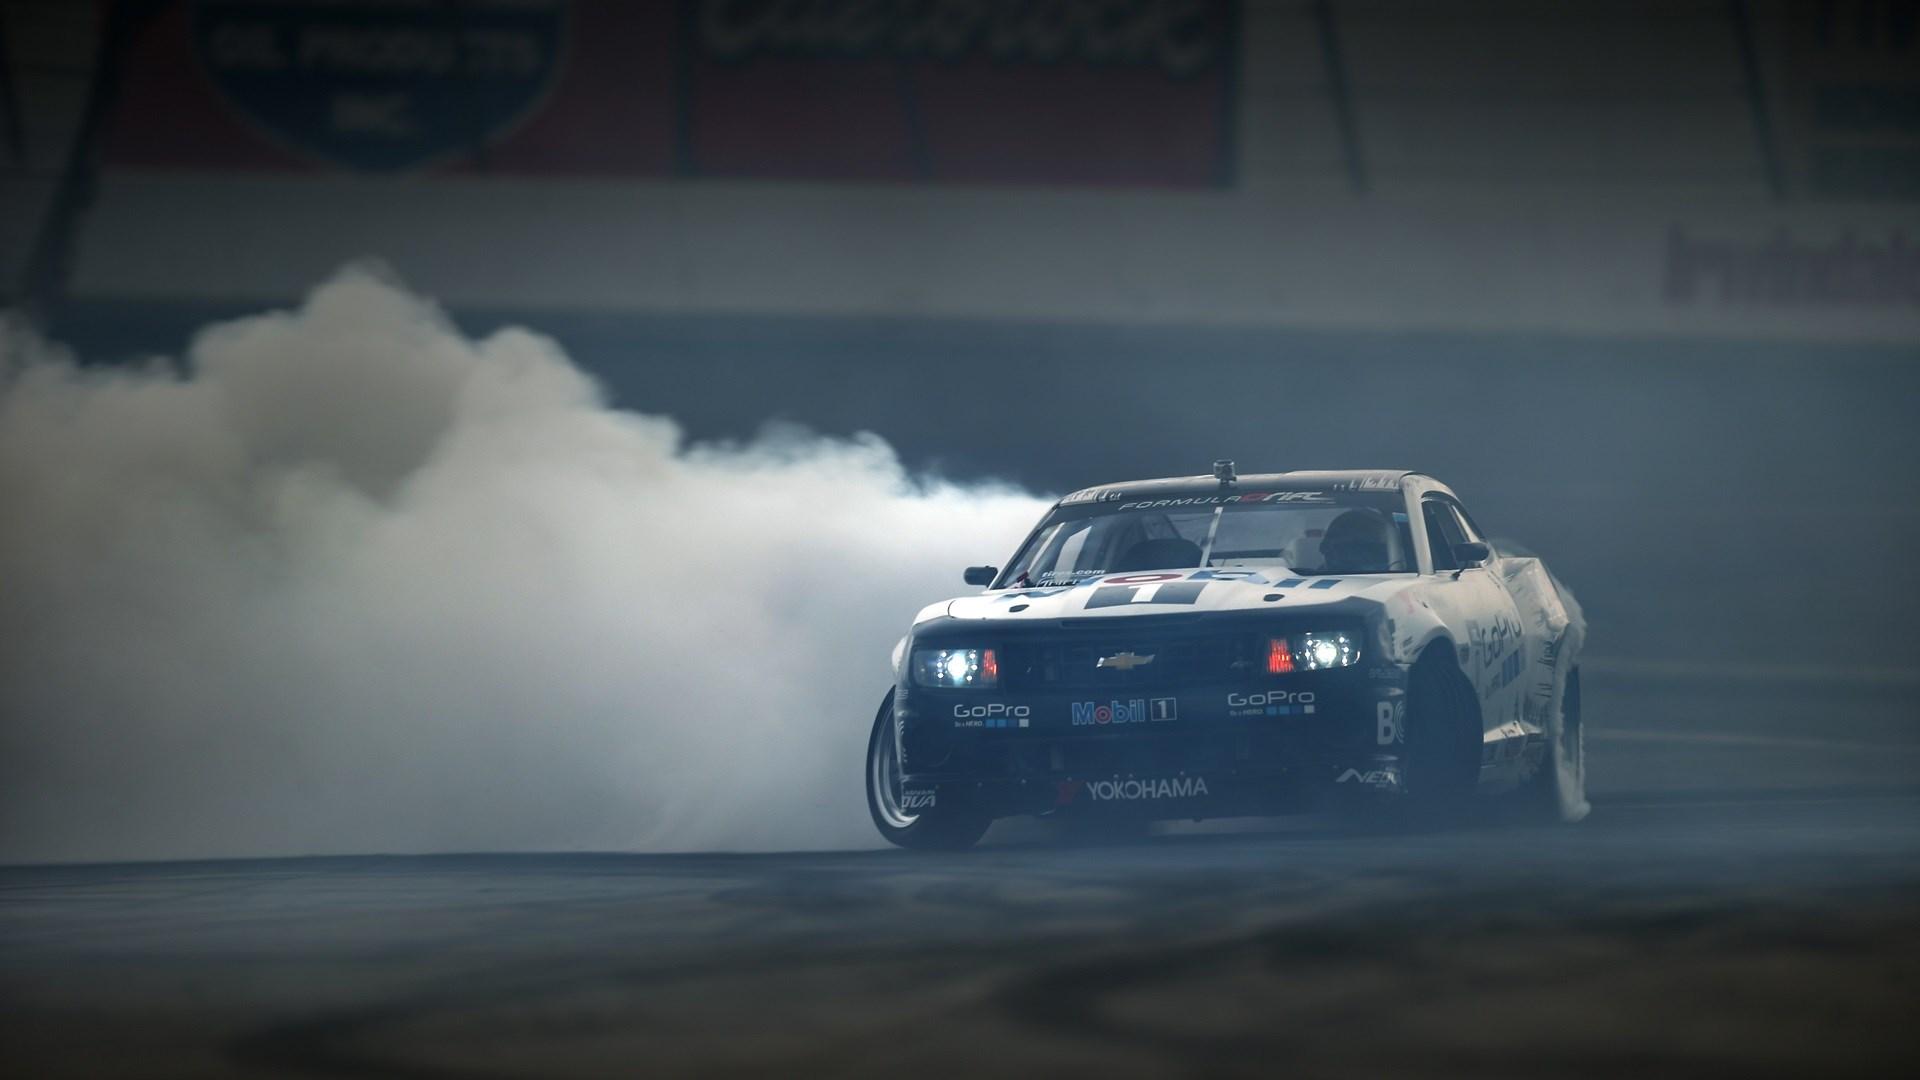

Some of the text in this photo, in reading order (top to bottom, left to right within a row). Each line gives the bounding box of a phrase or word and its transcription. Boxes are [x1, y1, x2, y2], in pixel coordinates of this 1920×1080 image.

[1227, 690, 1316, 706] GoPro
[953, 703, 1031, 718] GoPro
[1071, 699, 1146, 726] Mobil
[1086, 776, 1209, 801] YOKOHAMA
